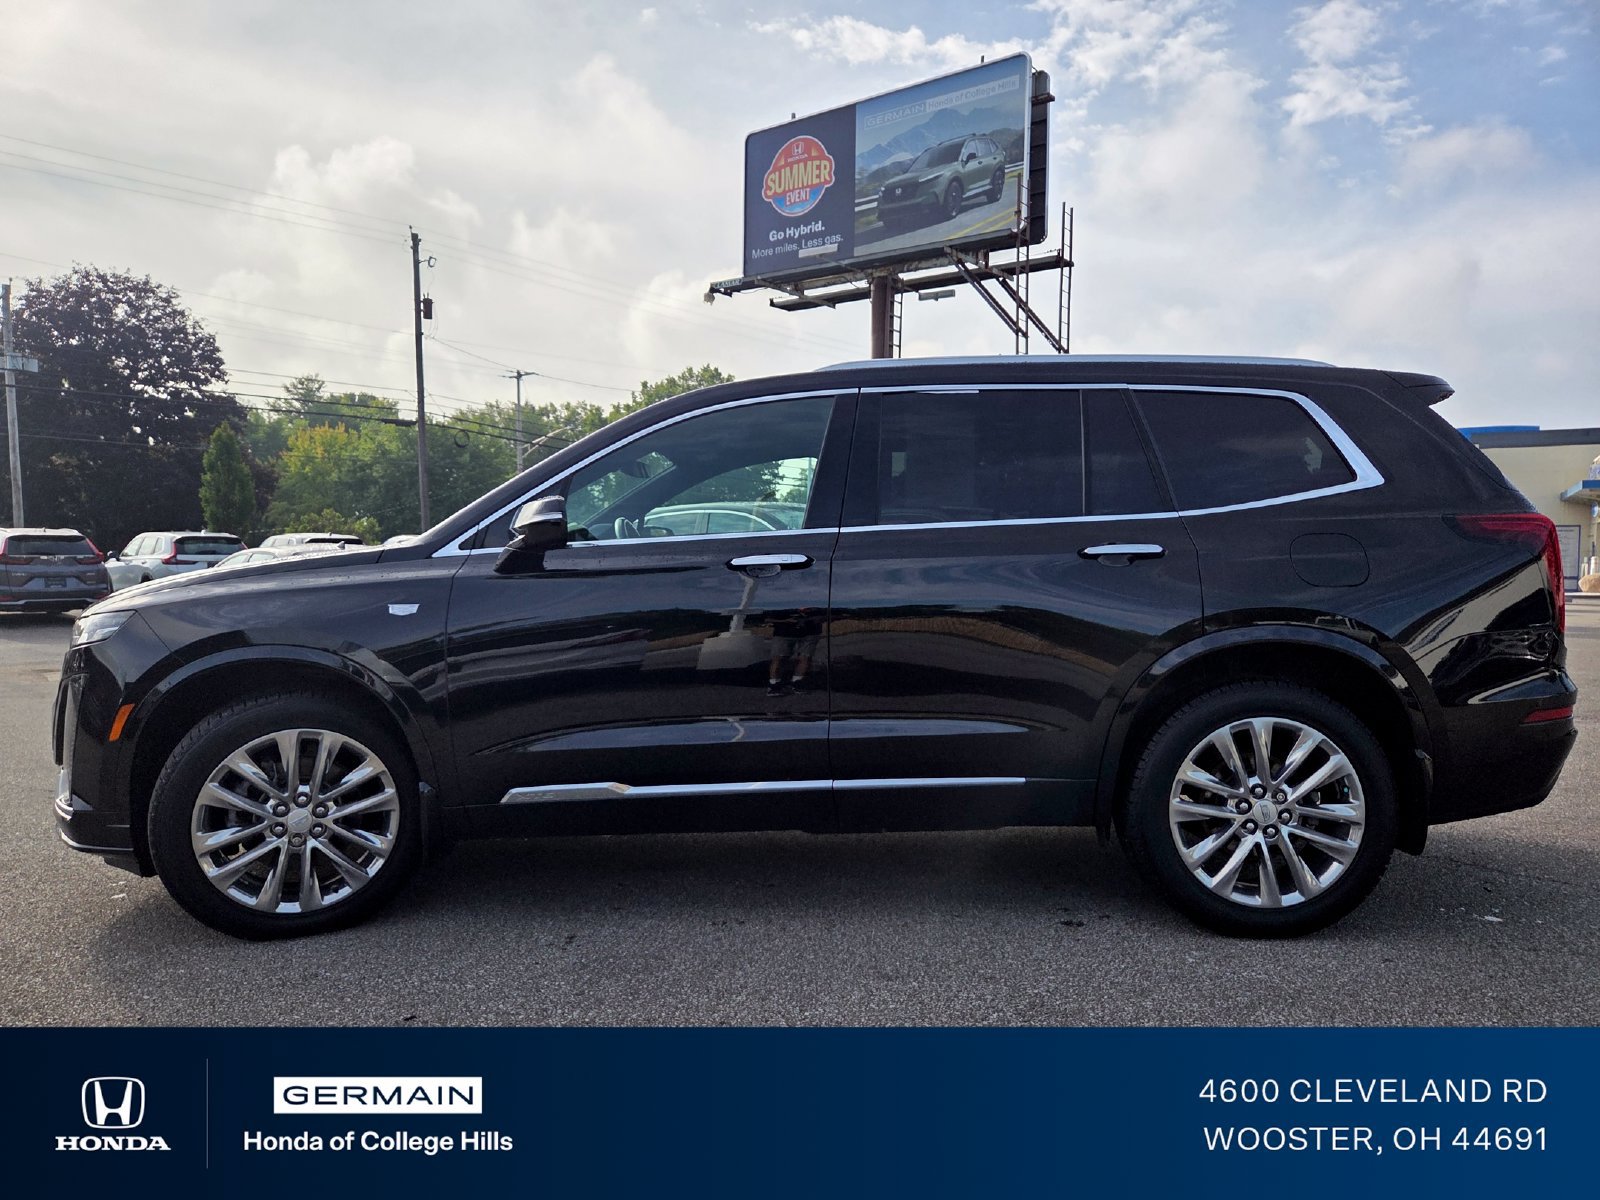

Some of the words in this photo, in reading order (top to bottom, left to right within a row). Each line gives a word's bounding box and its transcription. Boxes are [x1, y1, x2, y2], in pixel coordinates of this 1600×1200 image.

[866, 103, 925, 127] GERMAIN
[767, 160, 830, 196] SUMMER
[786, 188, 811, 206] EVENT
[769, 230, 785, 241] Go
[786, 221, 825, 239] Hybrid.
[752, 248, 773, 259] More
[775, 243, 799, 255] miles.
[802, 239, 822, 249] Less
[824, 234, 844, 246] gas.
